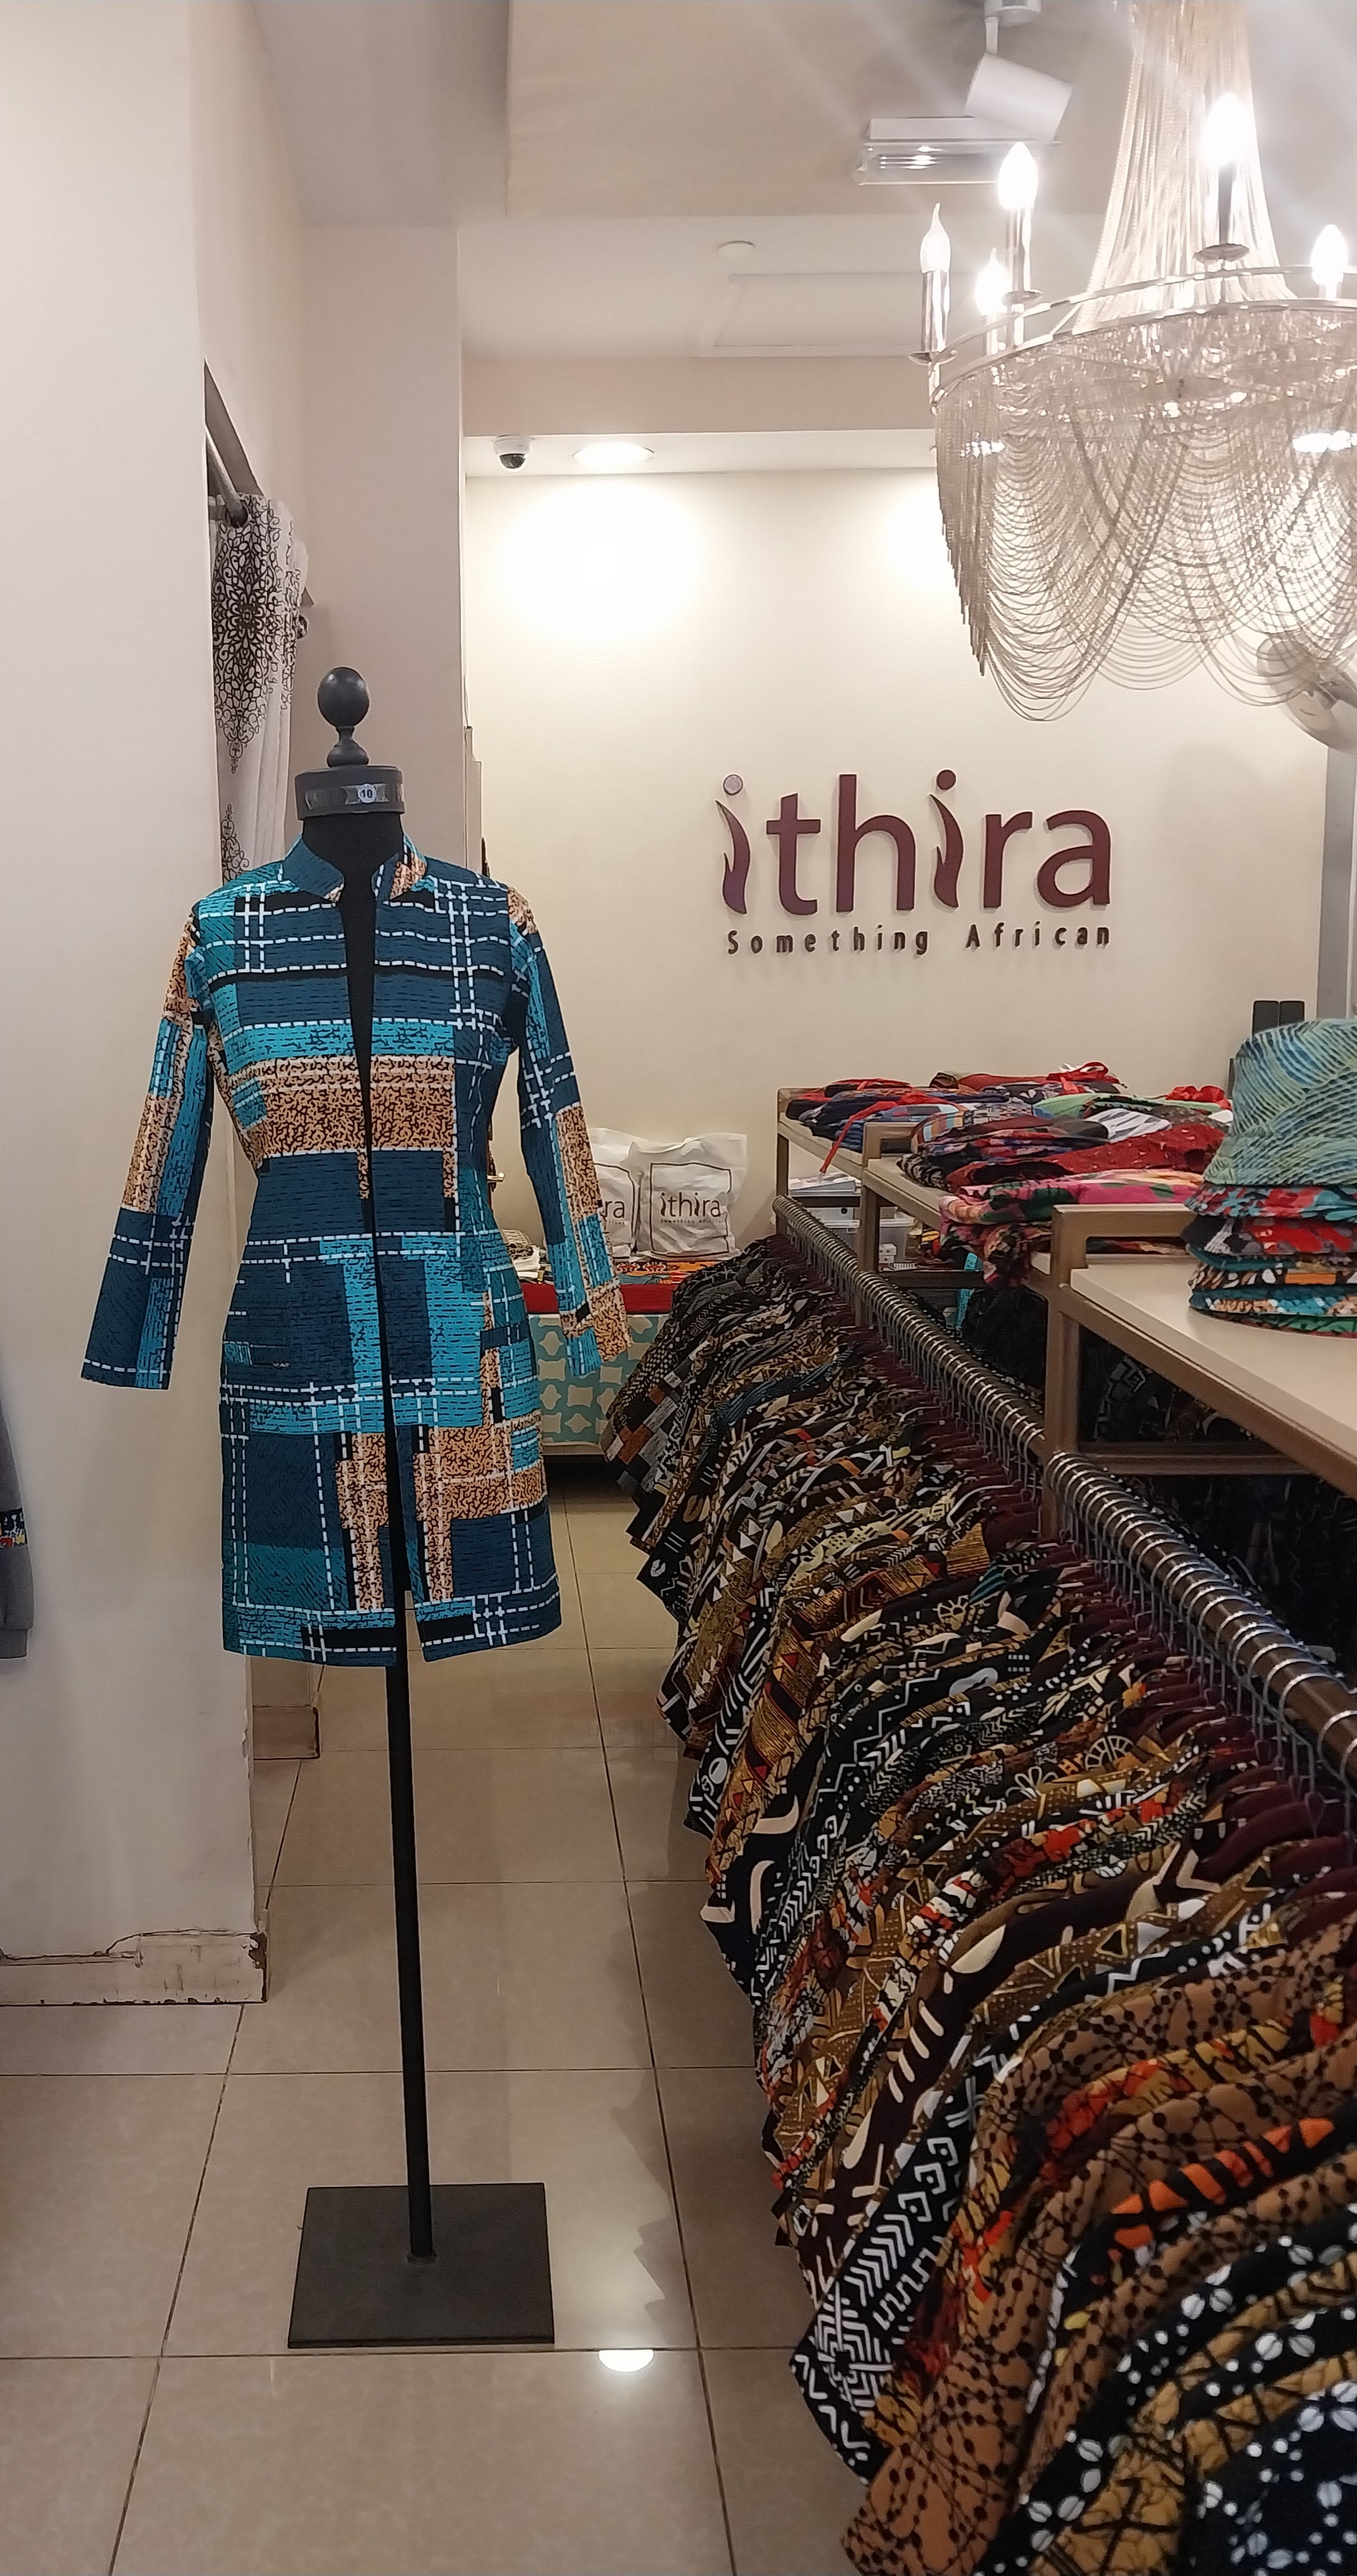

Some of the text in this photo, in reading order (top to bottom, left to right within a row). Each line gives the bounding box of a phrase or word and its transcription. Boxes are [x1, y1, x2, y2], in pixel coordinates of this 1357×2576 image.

[361, 789, 373, 799] 10
[715, 769, 1111, 915] ithira
[727, 921, 1109, 955] Something African
[660, 1192, 721, 1217] ithira
